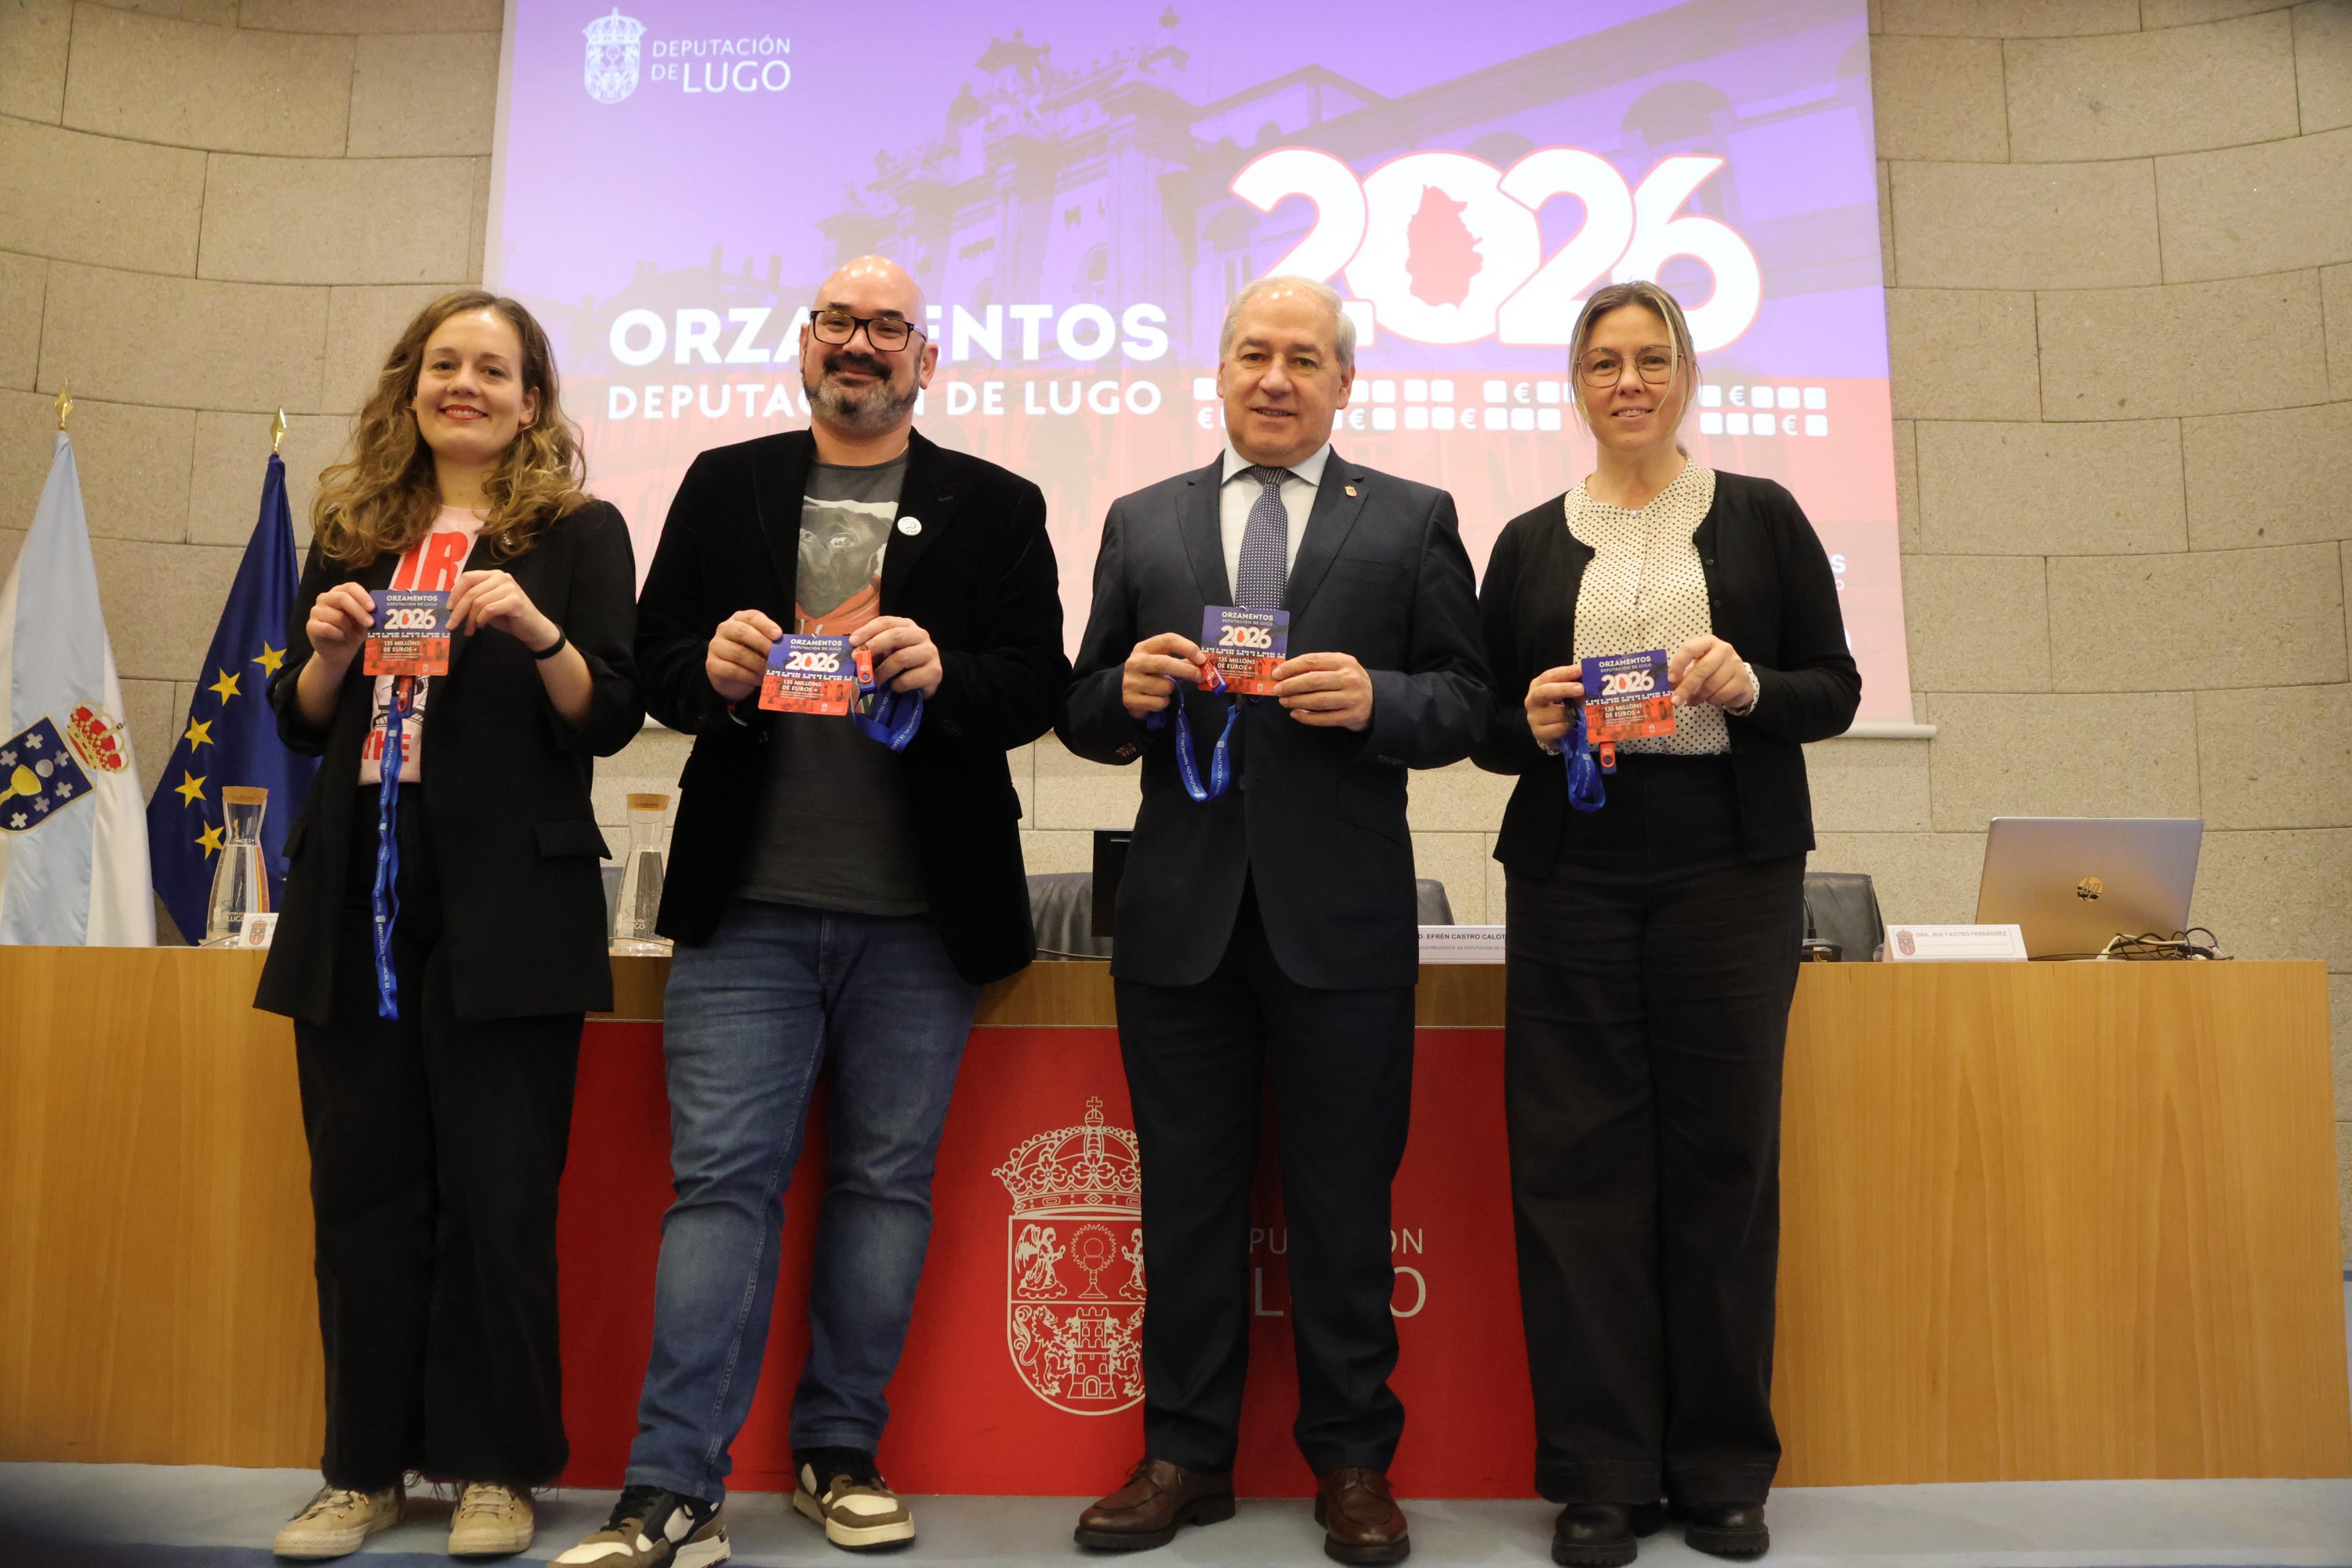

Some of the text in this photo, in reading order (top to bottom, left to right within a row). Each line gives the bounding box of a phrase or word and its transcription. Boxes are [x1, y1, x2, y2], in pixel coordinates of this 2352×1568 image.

[652, 34, 790, 57] DEPUTACIÓN
[651, 60, 791, 93] DE LUGO
[1231, 147, 1761, 352] 2026
[609, 303, 1169, 366] ORZANTOS
[608, 380, 1161, 419] DEPUTA DE LUGO
[384, 608, 436, 630] 2026
[1221, 612, 1274, 621] ORZAMENTOS
[1218, 625, 1272, 649] 2026
[785, 651, 840, 673] 2026
[1599, 655, 1652, 668] ORZAMENTOS
[1601, 670, 1655, 696] 2026
